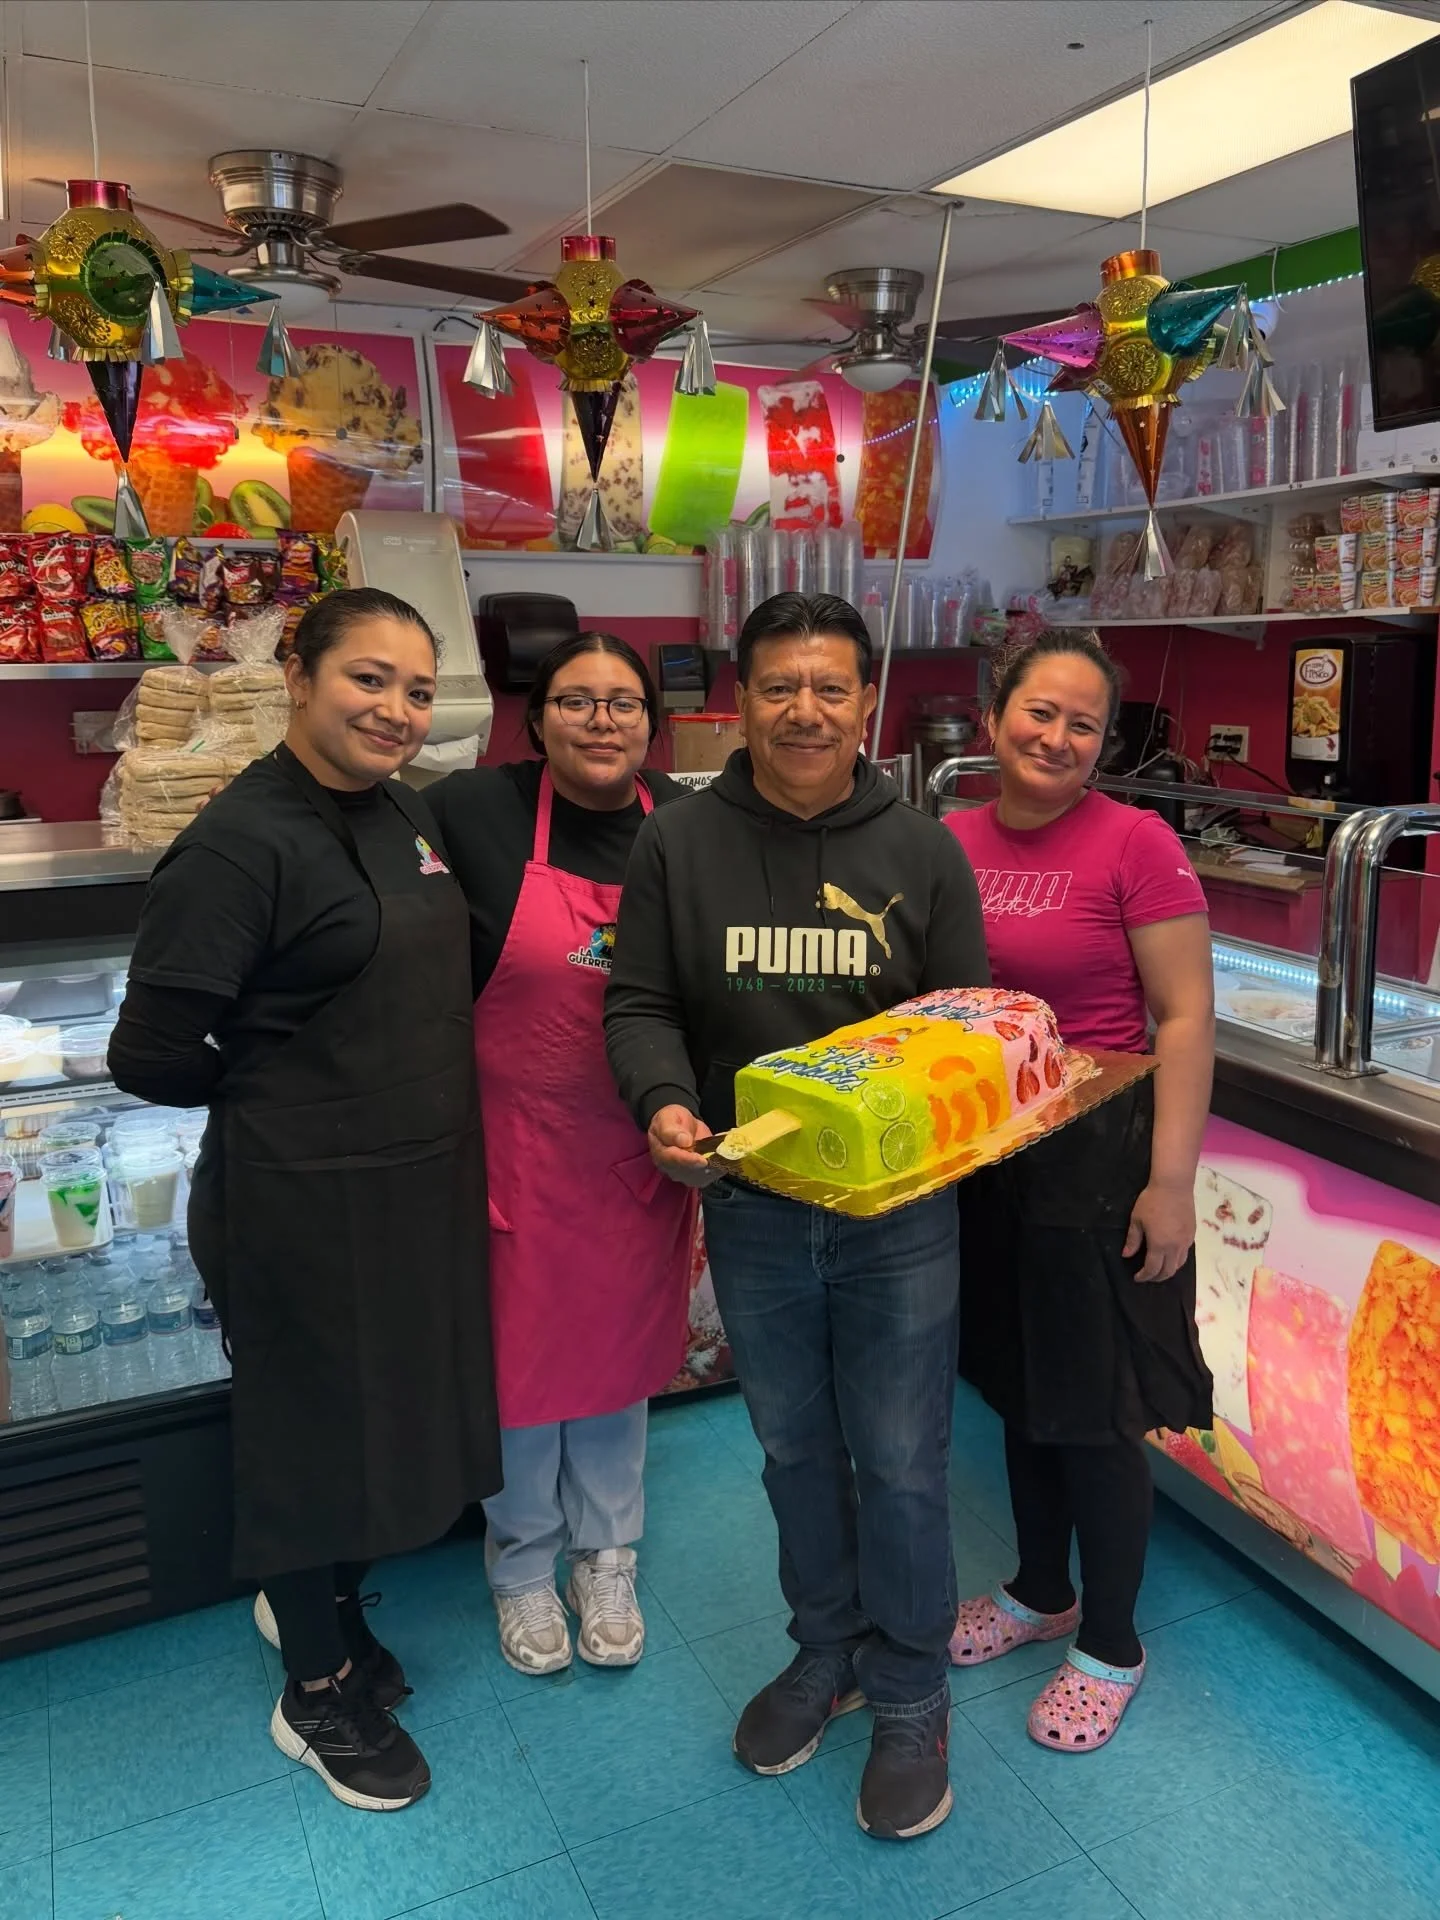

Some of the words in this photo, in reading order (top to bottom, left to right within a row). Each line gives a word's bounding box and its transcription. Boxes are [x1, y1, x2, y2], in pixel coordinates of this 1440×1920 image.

[974, 868, 1073, 910] UMA
[579, 947, 593, 958] LA
[726, 977, 764, 992] 1948
[787, 978, 825, 993] 2023
[848, 980, 866, 994] 75
